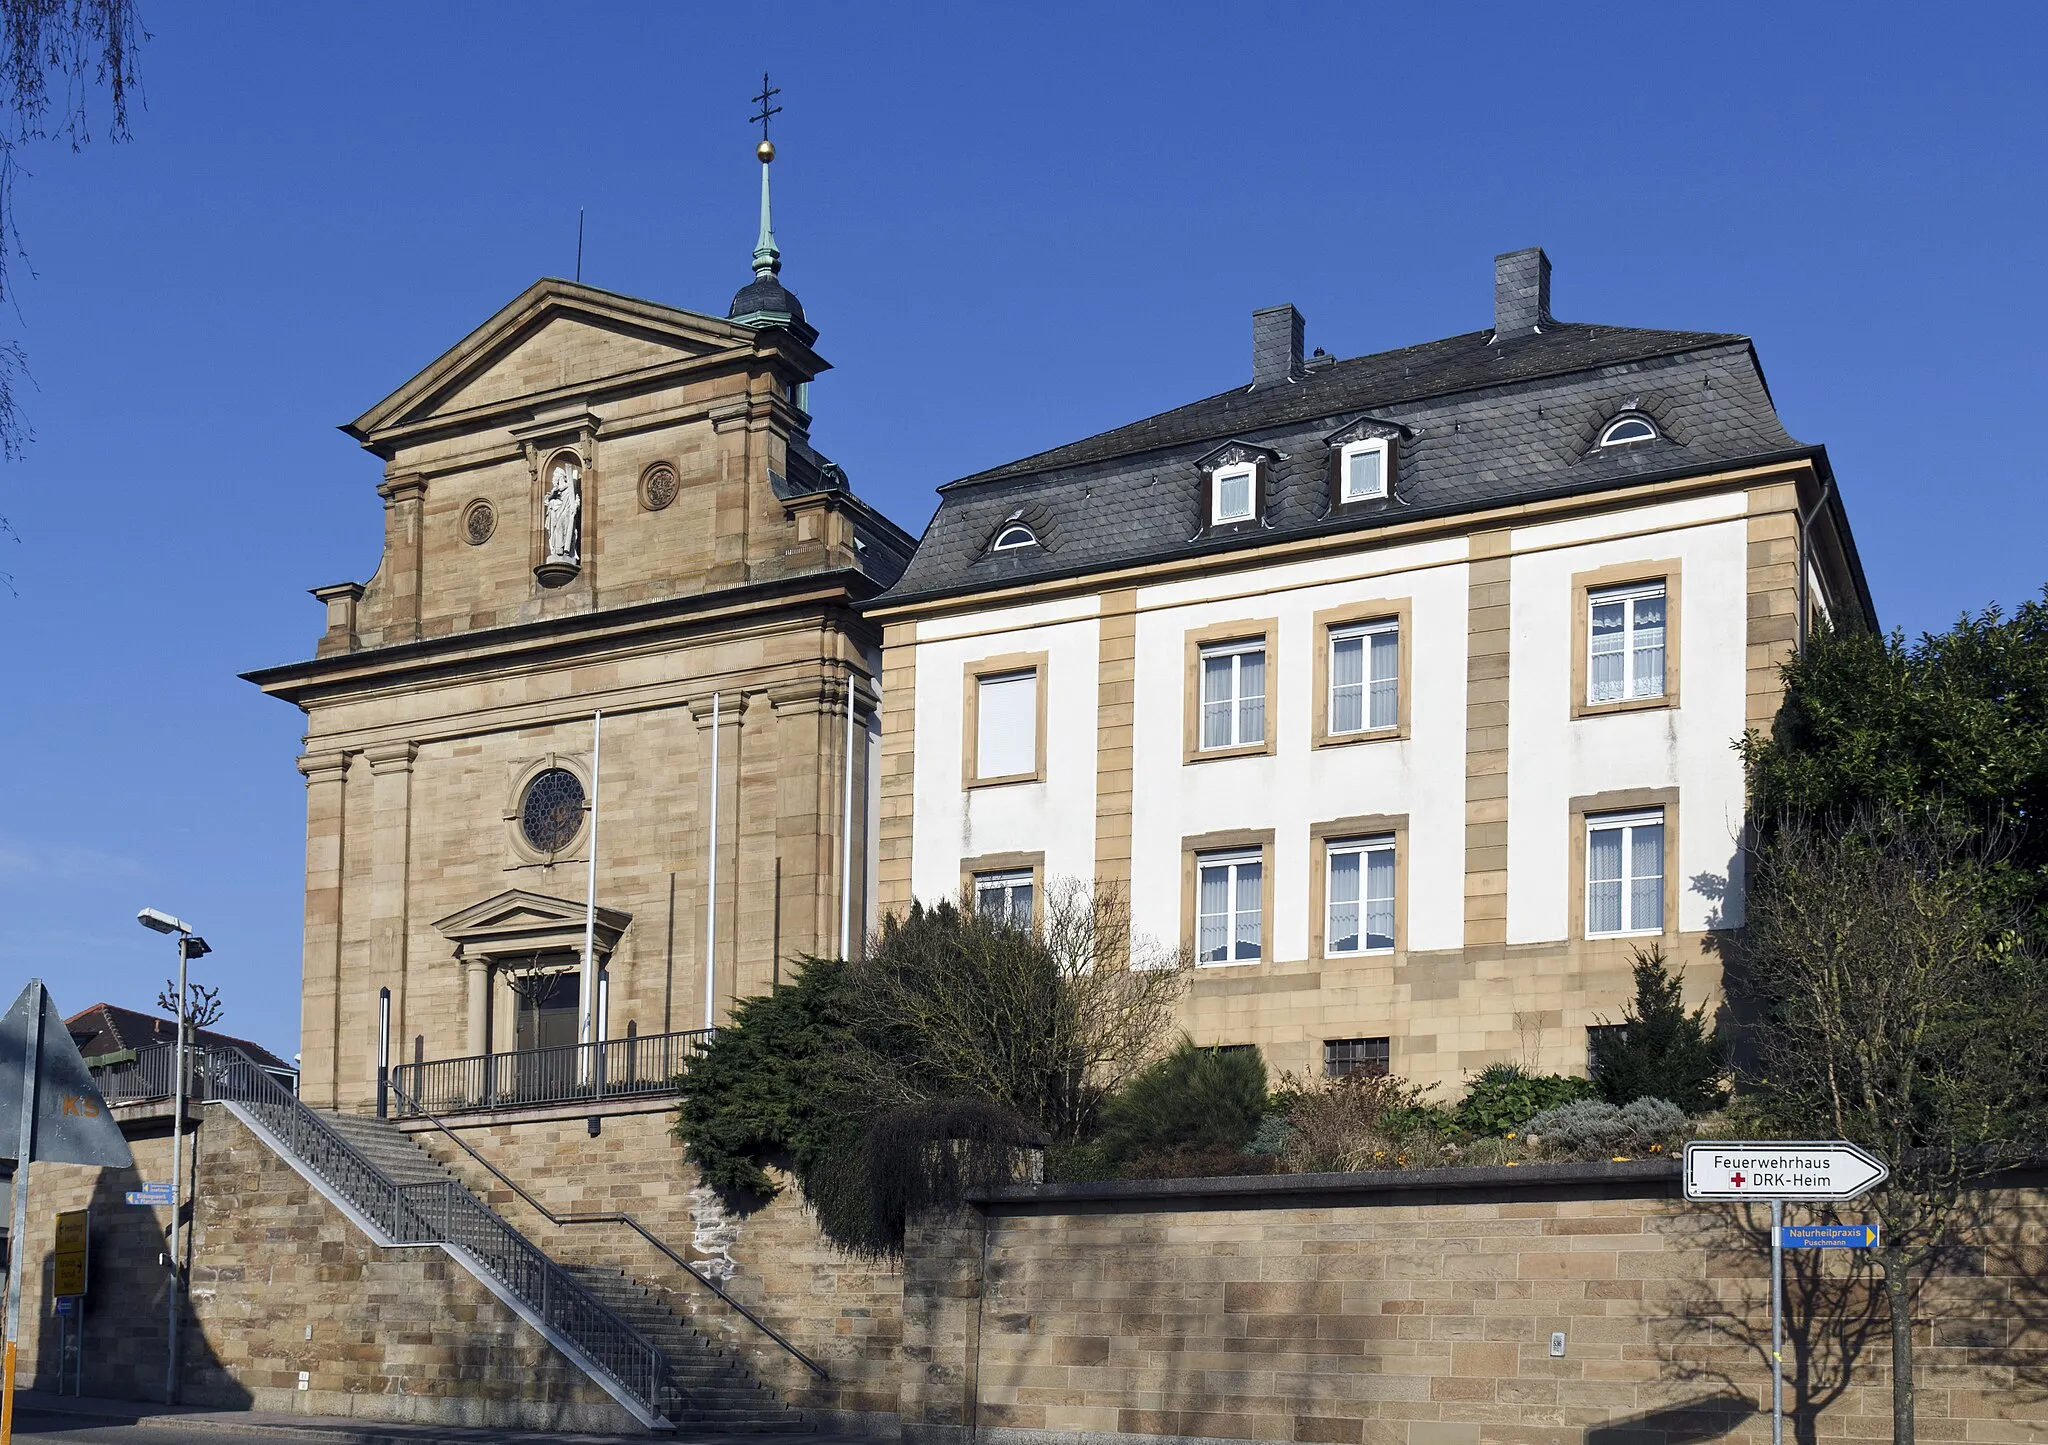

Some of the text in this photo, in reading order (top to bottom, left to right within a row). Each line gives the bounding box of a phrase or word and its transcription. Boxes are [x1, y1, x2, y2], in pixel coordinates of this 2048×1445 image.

[1714, 1155, 1830, 1169] Feuerwehrhaus
[1753, 1174, 1831, 1186] DRK-Heim
[1789, 1229, 1861, 1238] Naturheilpraxis
